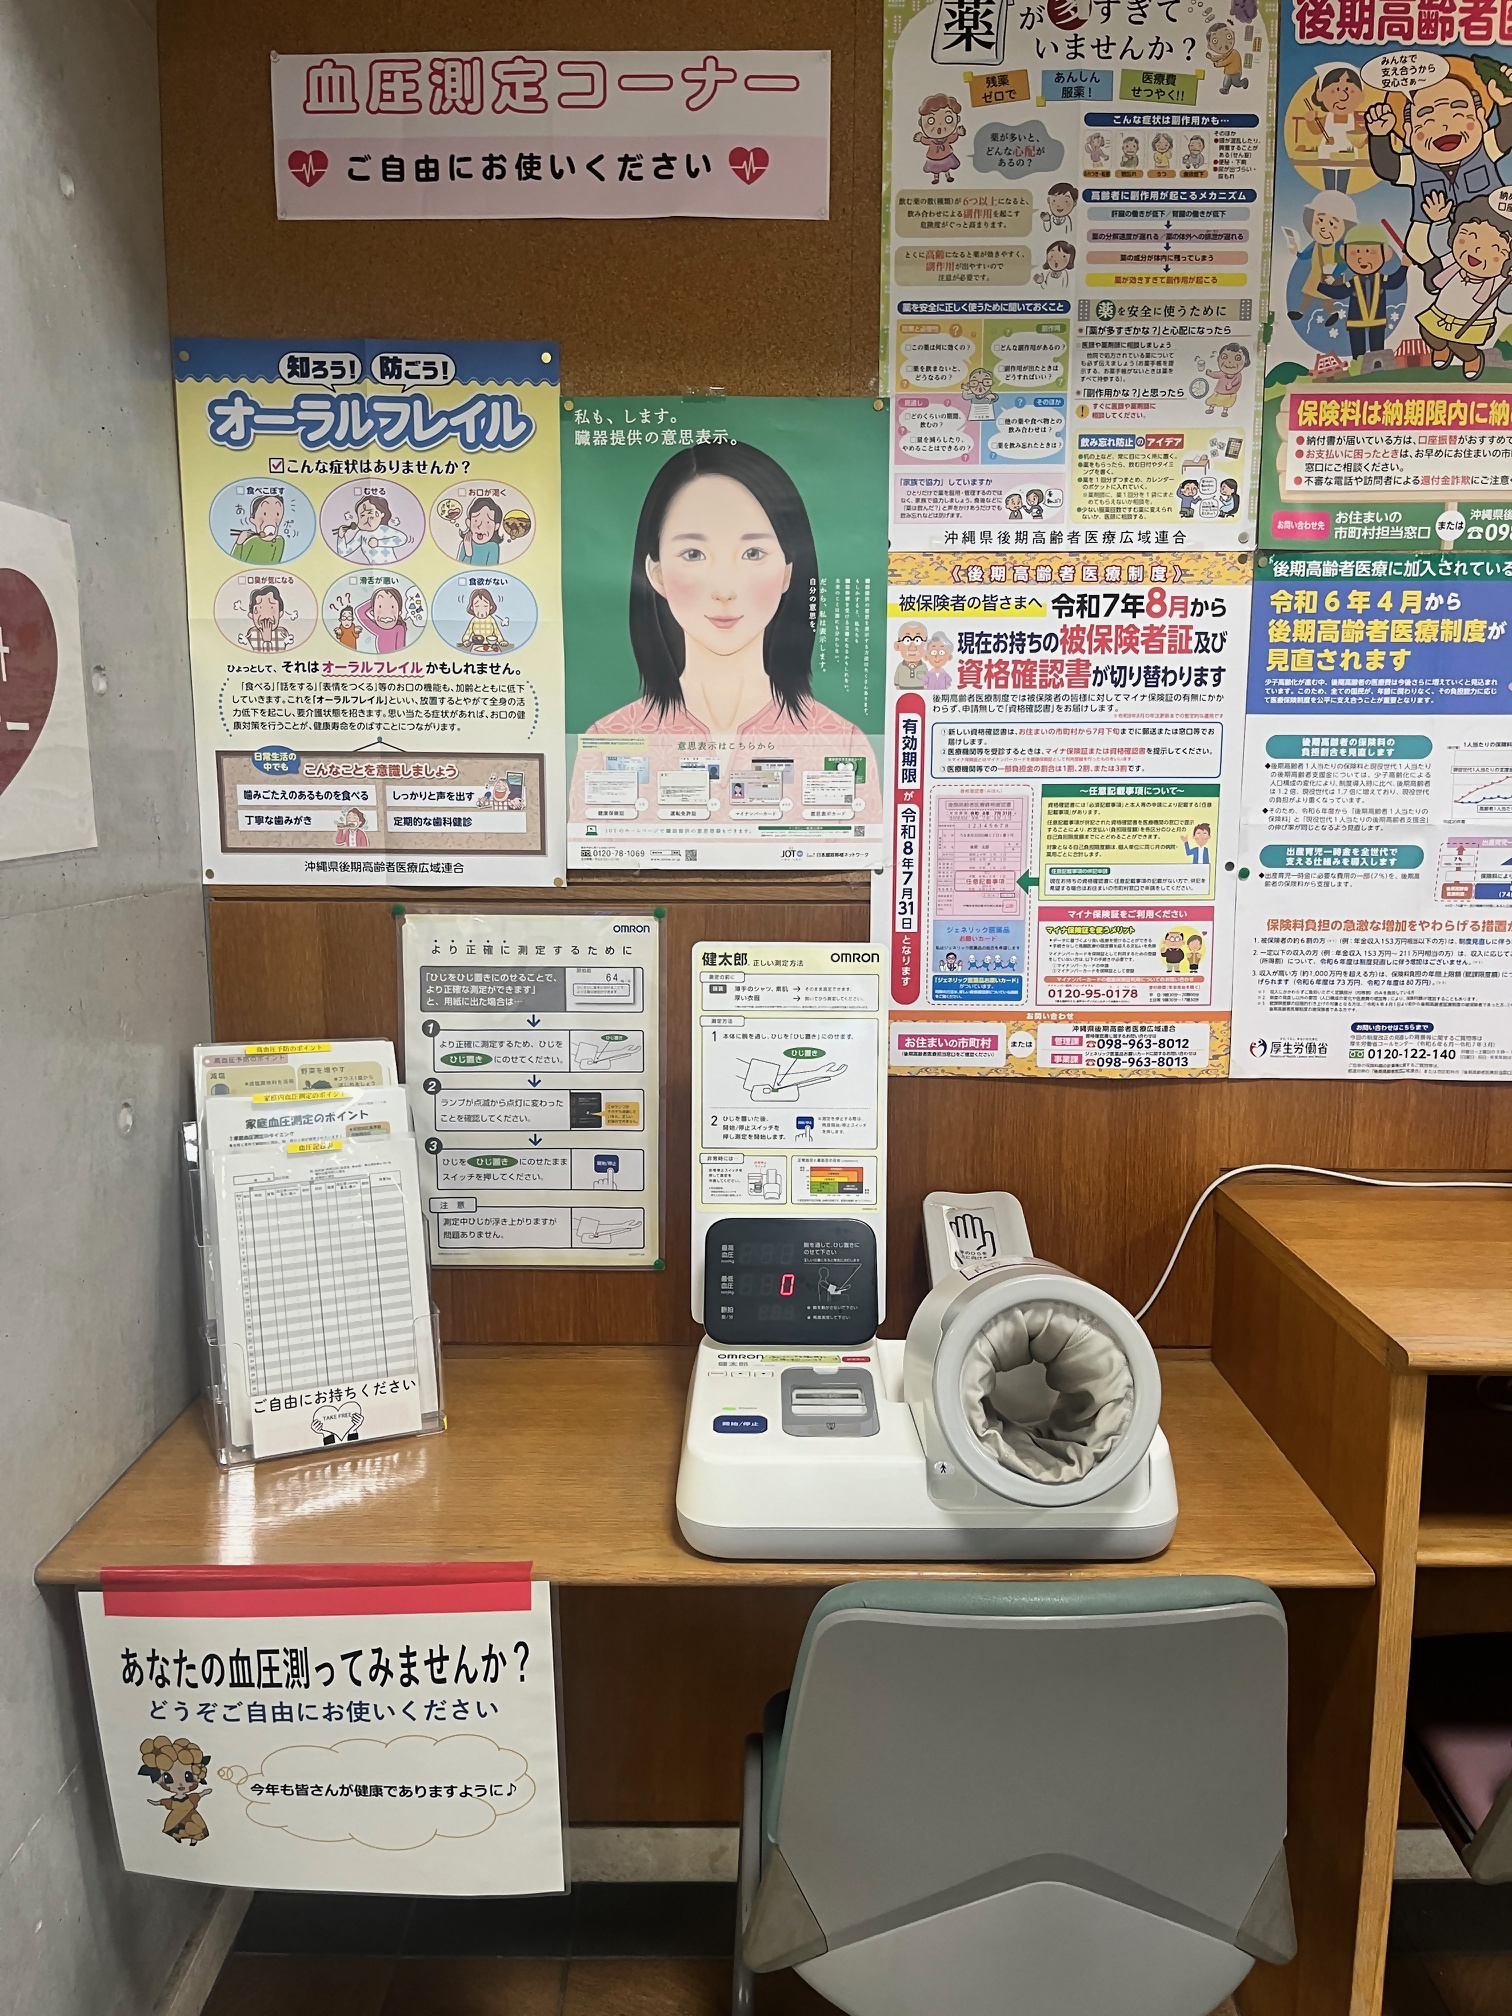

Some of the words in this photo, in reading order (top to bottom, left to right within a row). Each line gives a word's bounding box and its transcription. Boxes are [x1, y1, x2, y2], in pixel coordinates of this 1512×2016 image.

[1035, 34, 1197, 62] いませんか？
[1381, 54, 1418, 66] みんなで
[1381, 64, 1436, 77] 支え合うから
[985, 75, 1010, 89] 残薬
[1054, 72, 1101, 84] あんしん
[1141, 72, 1176, 86] 医療費
[303, 56, 801, 116] 血圧測定コーナー
[982, 89, 1018, 103] ゼロで
[985, 145, 1045, 157] どんな心配が
[347, 152, 712, 184] ご自由にお使いください
[1091, 190, 1247, 201] 高齢者に副作用が起こるメカニズム
[907, 208, 1020, 219] 飲み合わせによる副作用を起こす
[1120, 254, 1214, 262] 薬の成分が体内に残ってしまう
[925, 262, 1004, 272] 副作用が出やすいので
[1114, 275, 1218, 285] 薬が効きすぎて副作用が起こる
[1096, 300, 1227, 321] 薬を安全に使うために
[574, 408, 679, 425] 私も、します。
[1297, 399, 1512, 427] 保険料は納期限内に納
[208, 390, 533, 451] オーラルフレイル
[574, 428, 740, 447] 臓器提供の意思表示。
[1080, 436, 1183, 448] 飲み忘れ防止のアイデア
[1305, 449, 1512, 460] お支払いに困ったときは、お早めにお住まいの市
[286, 457, 471, 476] こんな症状はありませんか？
[1304, 462, 1404, 473] 窓口にご相談ください。
[246, 486, 286, 496] 食べこぼす
[363, 486, 387, 496] むせる
[468, 487, 507, 498] お口が渇く
[1335, 511, 1403, 524] お住まいの
[1277, 520, 1326, 531] お問い合わせ先
[1436, 520, 1464, 531] または
[944, 530, 1187, 545] 沖縄県後期高齢者医療広域連合
[1334, 525, 1431, 540] 市町村担当窓口
[248, 575, 295, 586] 口臭が気になる
[358, 575, 400, 587] 滑舌が悪い
[468, 576, 509, 587] 食欲がない
[808, 578, 817, 634] 自分の意思を。
[898, 594, 1043, 612] 被保険者の皆さまへ
[1051, 586, 1227, 620] 令和7年8月から
[1269, 589, 1463, 615] 令和６年４月から
[1268, 618, 1508, 643] 後期高齢者医療制度が
[957, 623, 1228, 656] 現在お持ちの被保険者証及び
[1265, 648, 1412, 673] 見直されます
[957, 657, 1227, 690] 資格確認書が切り替わります
[676, 740, 776, 752] 意思表示はこちらから
[1301, 737, 1396, 748] 後期高齢者の保険料の
[254, 752, 298, 763] 日常生活の
[1301, 747, 1395, 757] 負担割合を見直します
[262, 762, 290, 773] 中でも
[303, 762, 460, 779] こんなことを意識しましょう
[243, 789, 370, 802] 噛みごたえのあるものを食べる
[391, 790, 475, 803] しっかりと声を出す
[244, 814, 313, 827] 丁寧な歯みがき
[392, 815, 474, 828] 定期的な歯科健診
[592, 849, 646, 858] 0120-78-1069
[780, 849, 796, 859] JOT
[1285, 847, 1398, 857] 出産育児一時金を全世代で
[304, 860, 465, 875] 沖縄県後期高齢者医療広域連合
[1285, 856, 1398, 867] 支える仕組みを導入します
[1067, 909, 1188, 919] マイナ保険証をご利用ください
[612, 924, 651, 934] OMRON
[946, 926, 1011, 935] ジェネリック医薬品
[1045, 925, 1136, 935] マイナ保険証を使うメリット
[959, 935, 998, 943] お願いカード
[430, 944, 633, 956] より正確に測定するために
[701, 951, 749, 967] 健太郎
[752, 959, 804, 967] 正しい測定方法
[830, 952, 880, 963] OMRON
[605, 972, 619, 983] 64
[1047, 988, 1139, 999] 0120-95-0178
[1025, 1012, 1075, 1021] お問い合わせ
[1071, 1024, 1177, 1033] 沖縄県後期高齢者医療広域連合
[1355, 1023, 1429, 1032] お問い合わせはこちらまで
[904, 1036, 992, 1049] お住まいの市町村
[1010, 1040, 1033, 1048] または
[1054, 1037, 1080, 1046] 管理課
[1096, 1038, 1190, 1050] 098-963-8012
[256, 1043, 323, 1054] 高血圧予防のポイント
[791, 1049, 818, 1057] ひじ置き
[1270, 1042, 1328, 1056] 厚生労働省
[1368, 1048, 1457, 1060] 0120-122-140
[213, 1054, 286, 1065] 高血圧予防のポイント
[449, 1054, 484, 1064] ひじ置き
[1053, 1055, 1079, 1064] 事業課
[1096, 1056, 1189, 1068] 098-963-8013
[300, 1065, 346, 1075] 野菜を増やす
[209, 1072, 226, 1081] 減塩
[440, 1098, 564, 1108] ランプが点滅から点灯に変わった
[245, 1109, 369, 1130] 家庭血圧測定のポイント
[722, 1124, 780, 1132] 開始/停止スイッチを
[442, 1216, 557, 1226] 測定中ひじが浮き上がりますが
[443, 1230, 505, 1239] 問題ありません。
[780, 1273, 796, 1296] 0
[254, 1379, 417, 1414] ご自由にお持ちください
[119, 1640, 531, 1690] あなたの血圧測ってみませんか？
[149, 1698, 499, 1724] どうぞご自由にお使いください
